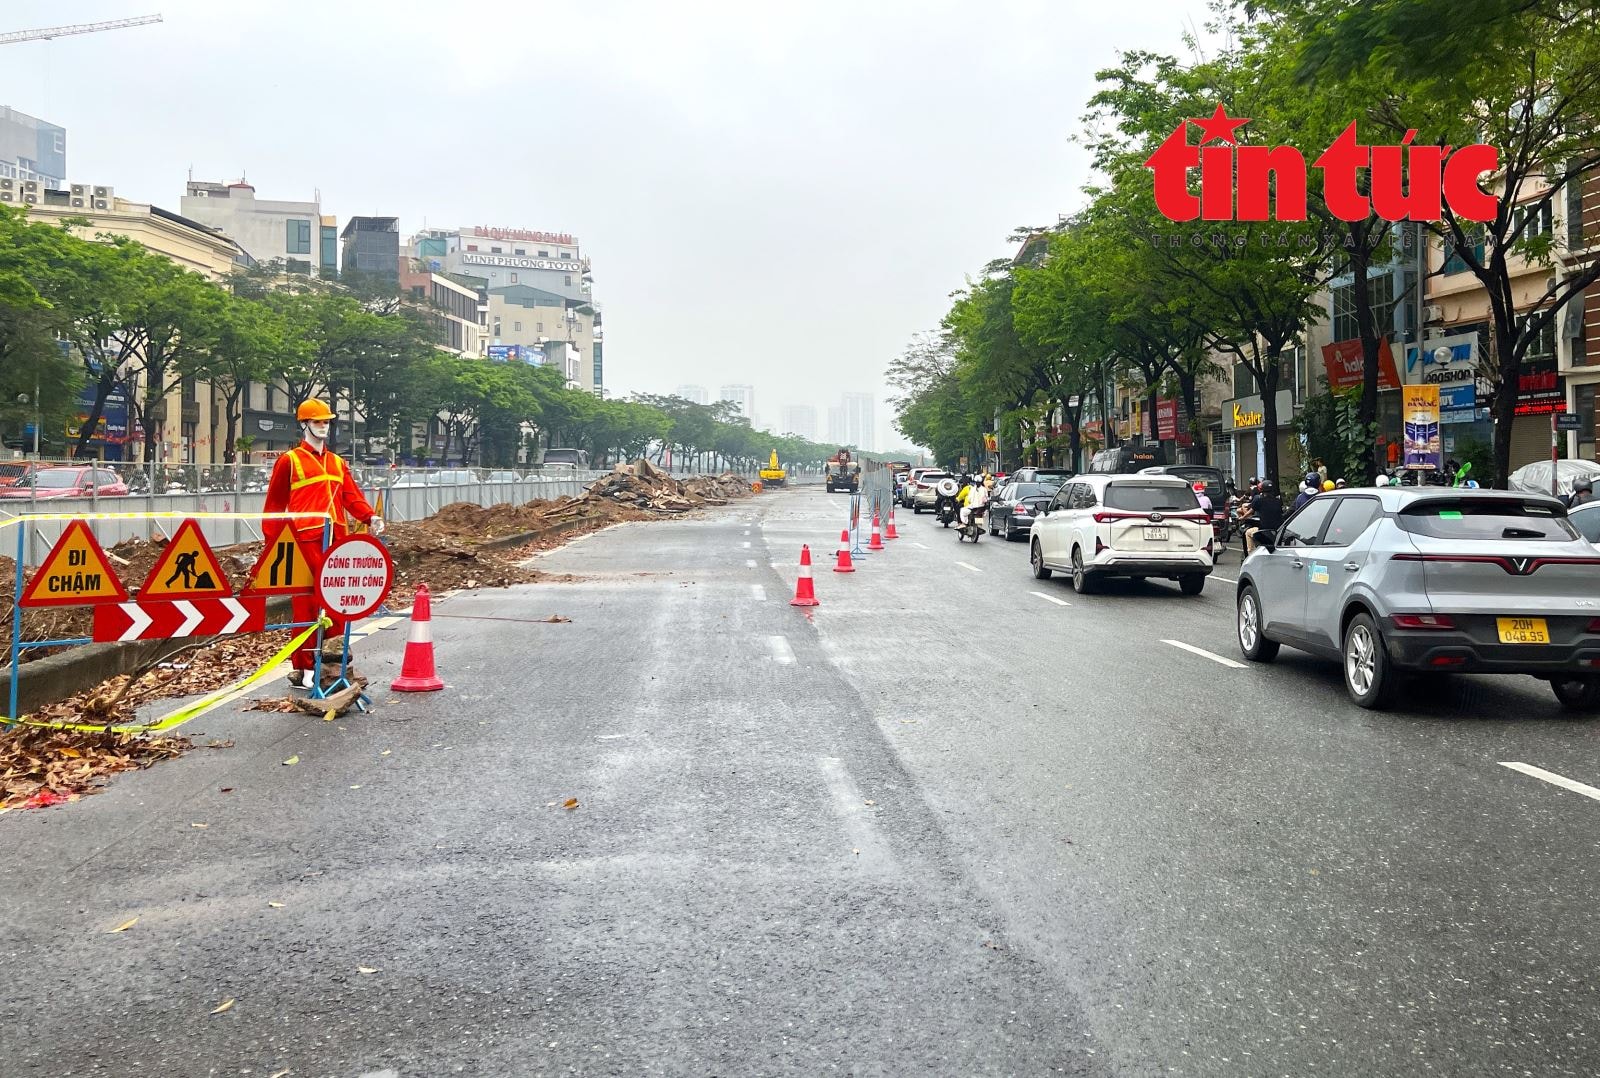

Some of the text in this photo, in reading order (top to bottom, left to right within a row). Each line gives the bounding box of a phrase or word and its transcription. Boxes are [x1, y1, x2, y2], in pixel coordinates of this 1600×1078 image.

[464, 253, 495, 265] MINH
[546, 261, 580, 271] TOTO
[68, 549, 87, 566] ĐI
[327, 554, 350, 569] CÔNG
[48, 571, 101, 594] CHẬM
[347, 576, 361, 588] THI
[362, 573, 384, 587] CÔNG
[1511, 619, 1534, 630] 20H
[1504, 631, 1545, 642] 048.95
